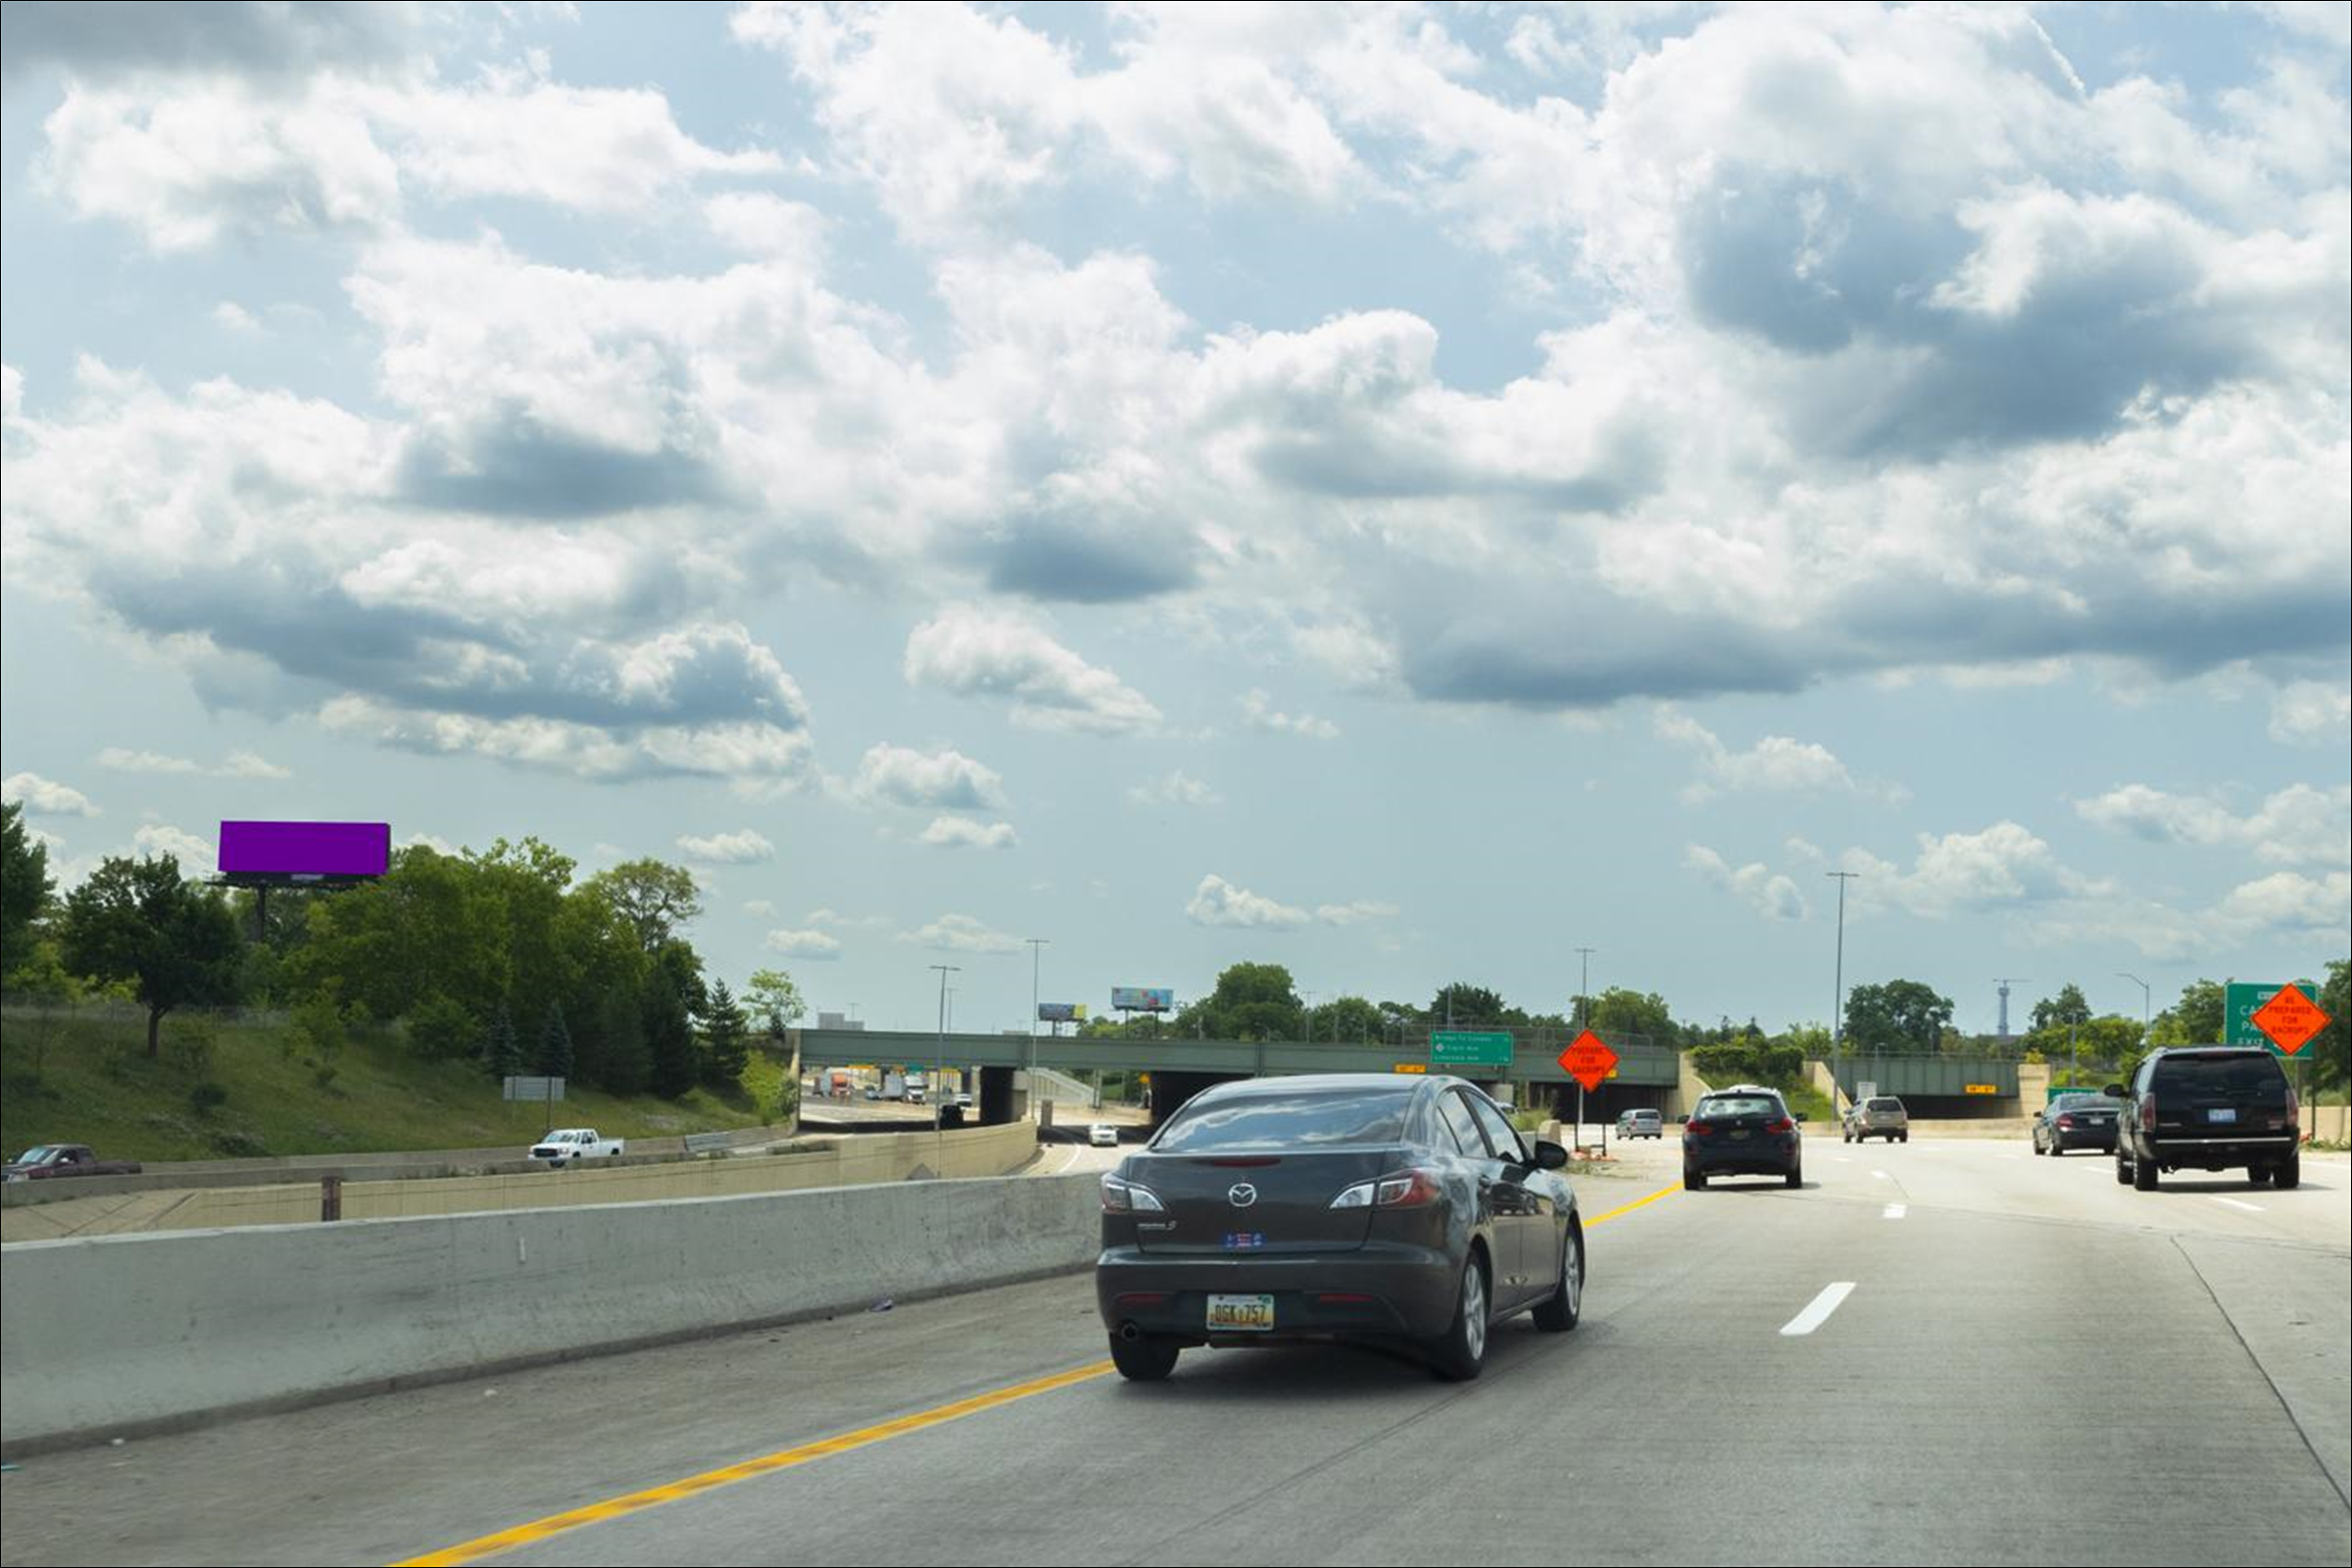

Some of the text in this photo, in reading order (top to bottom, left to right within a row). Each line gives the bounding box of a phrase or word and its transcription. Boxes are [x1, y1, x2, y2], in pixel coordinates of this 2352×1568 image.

[2268, 1005, 2312, 1014] PREPARED
[1580, 1055, 1596, 1064] FOR
[1245, 1304, 1266, 1322] 757
